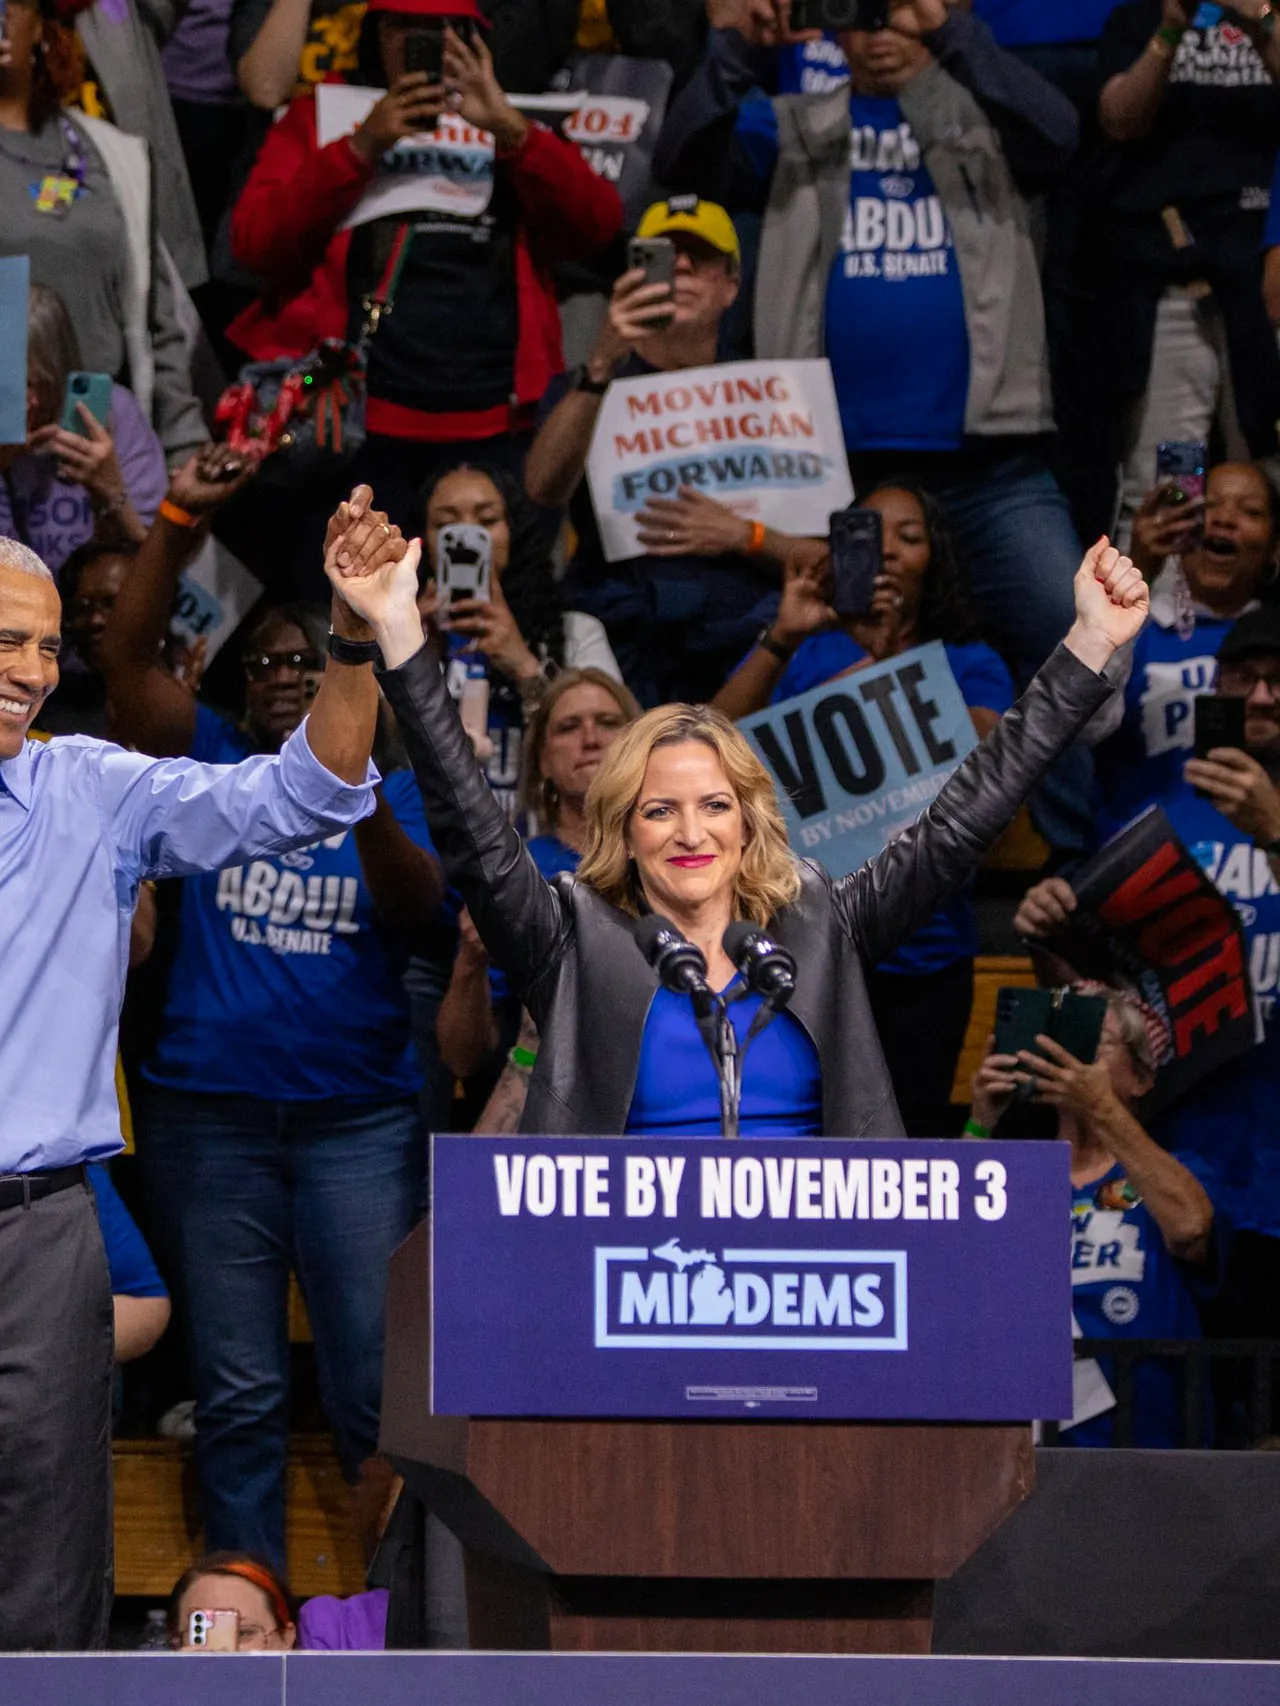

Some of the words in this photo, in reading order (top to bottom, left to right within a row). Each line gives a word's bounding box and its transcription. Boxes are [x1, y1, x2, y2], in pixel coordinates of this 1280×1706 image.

[883, 250, 948, 276] SENATE
[627, 377, 790, 421] MOVING
[613, 412, 816, 459] MICHIGAN
[622, 452, 824, 500] FORWARD
[751, 660, 957, 820] VOTE
[799, 820, 832, 849] BY
[216, 860, 360, 934] ABDUL
[265, 923, 332, 955] SENATE
[1099, 841, 1248, 1057] VOTE
[494, 1155, 610, 1217] VOTE
[626, 1156, 686, 1218] BY
[701, 1158, 959, 1220] NOVEMBER
[974, 1159, 1008, 1221] 3
